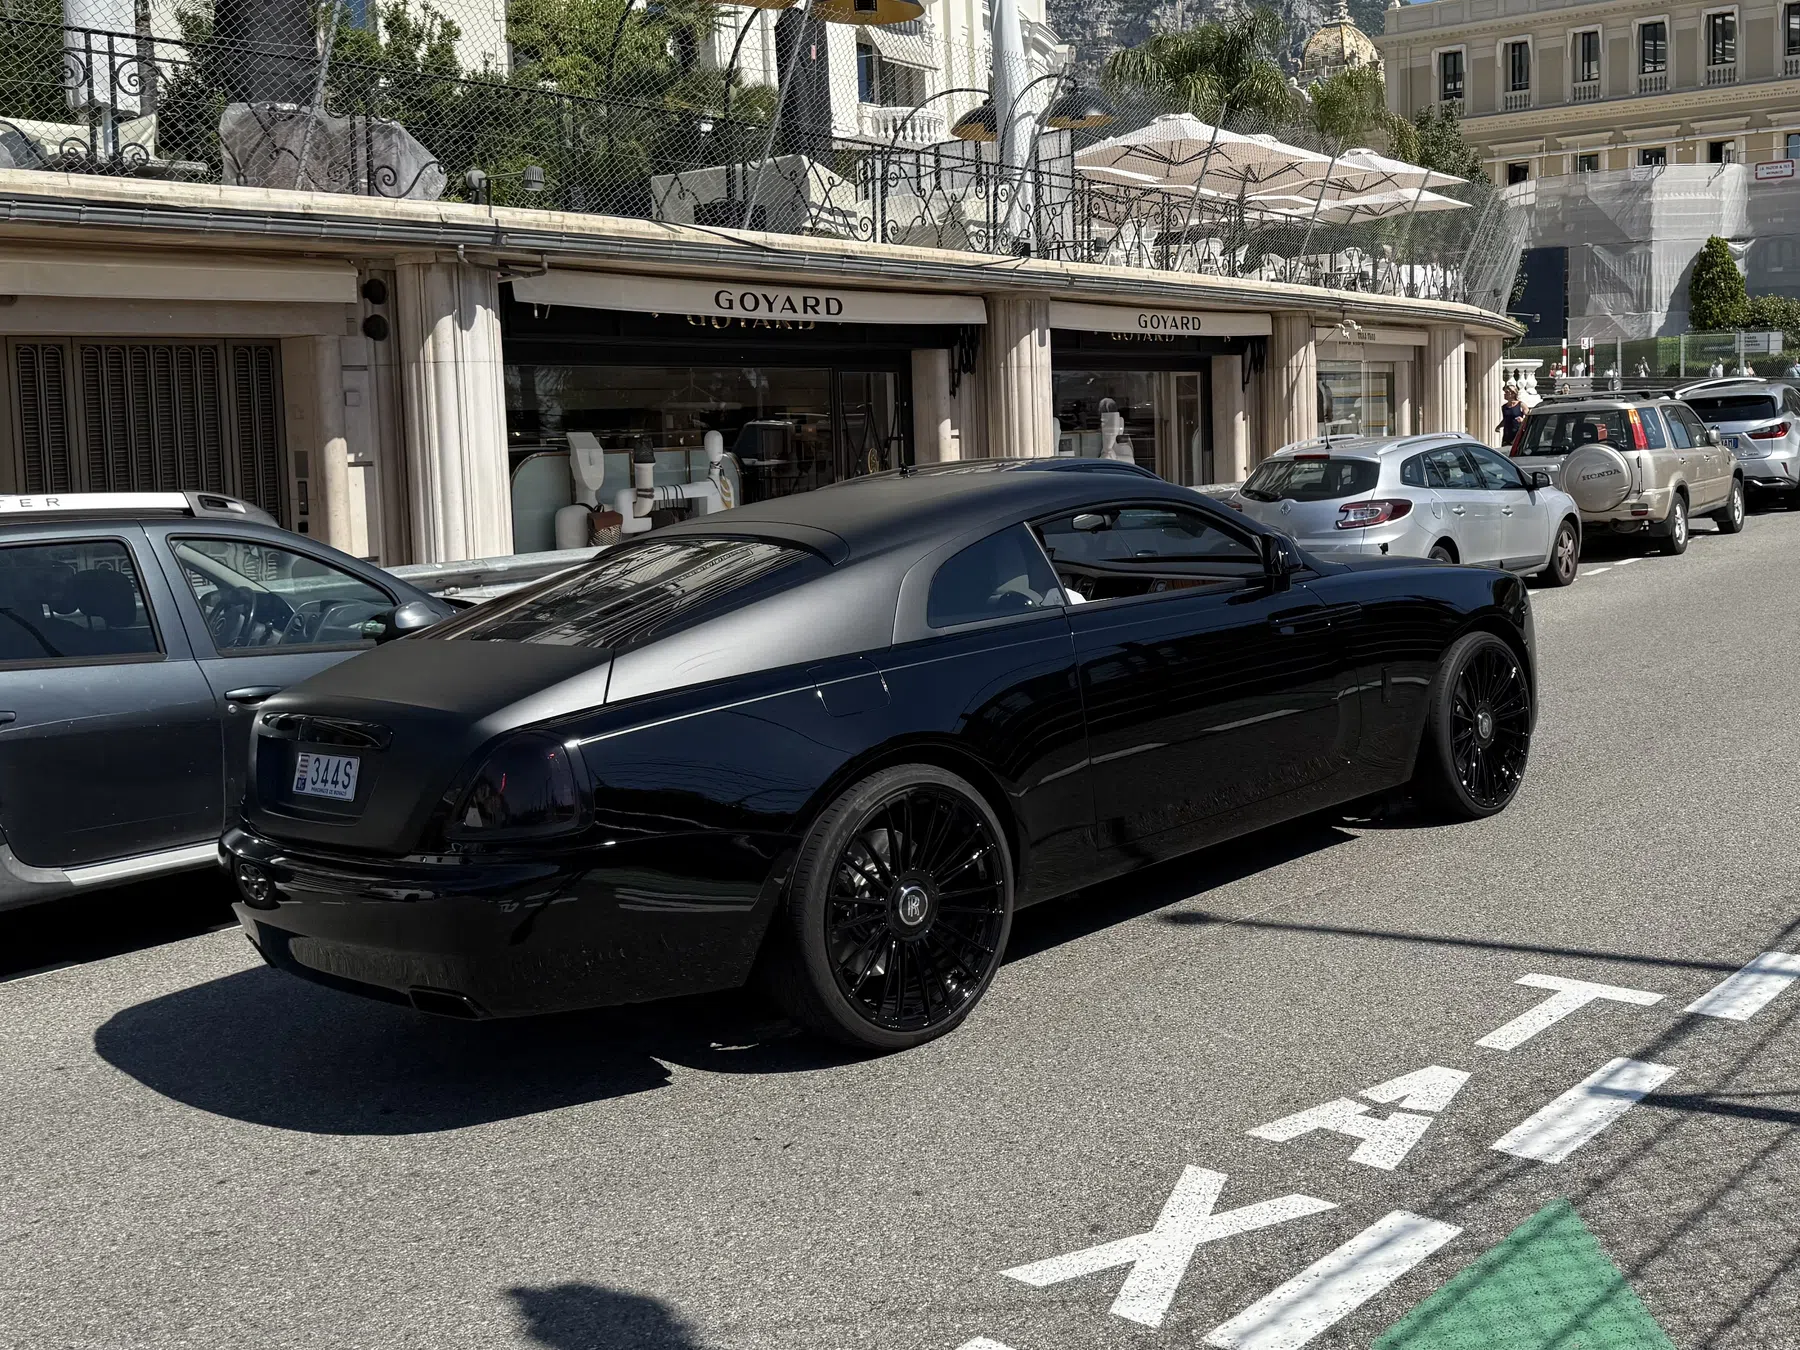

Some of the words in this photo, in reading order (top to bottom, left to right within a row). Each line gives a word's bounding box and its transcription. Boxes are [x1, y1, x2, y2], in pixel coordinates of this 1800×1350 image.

[714, 290, 843, 316] GOYARD
[1138, 314, 1201, 330] GOYARD
[1582, 469, 1621, 481] HONDA
[311, 757, 352, 790] 344S
[955, 972, 1664, 1350] TAX
